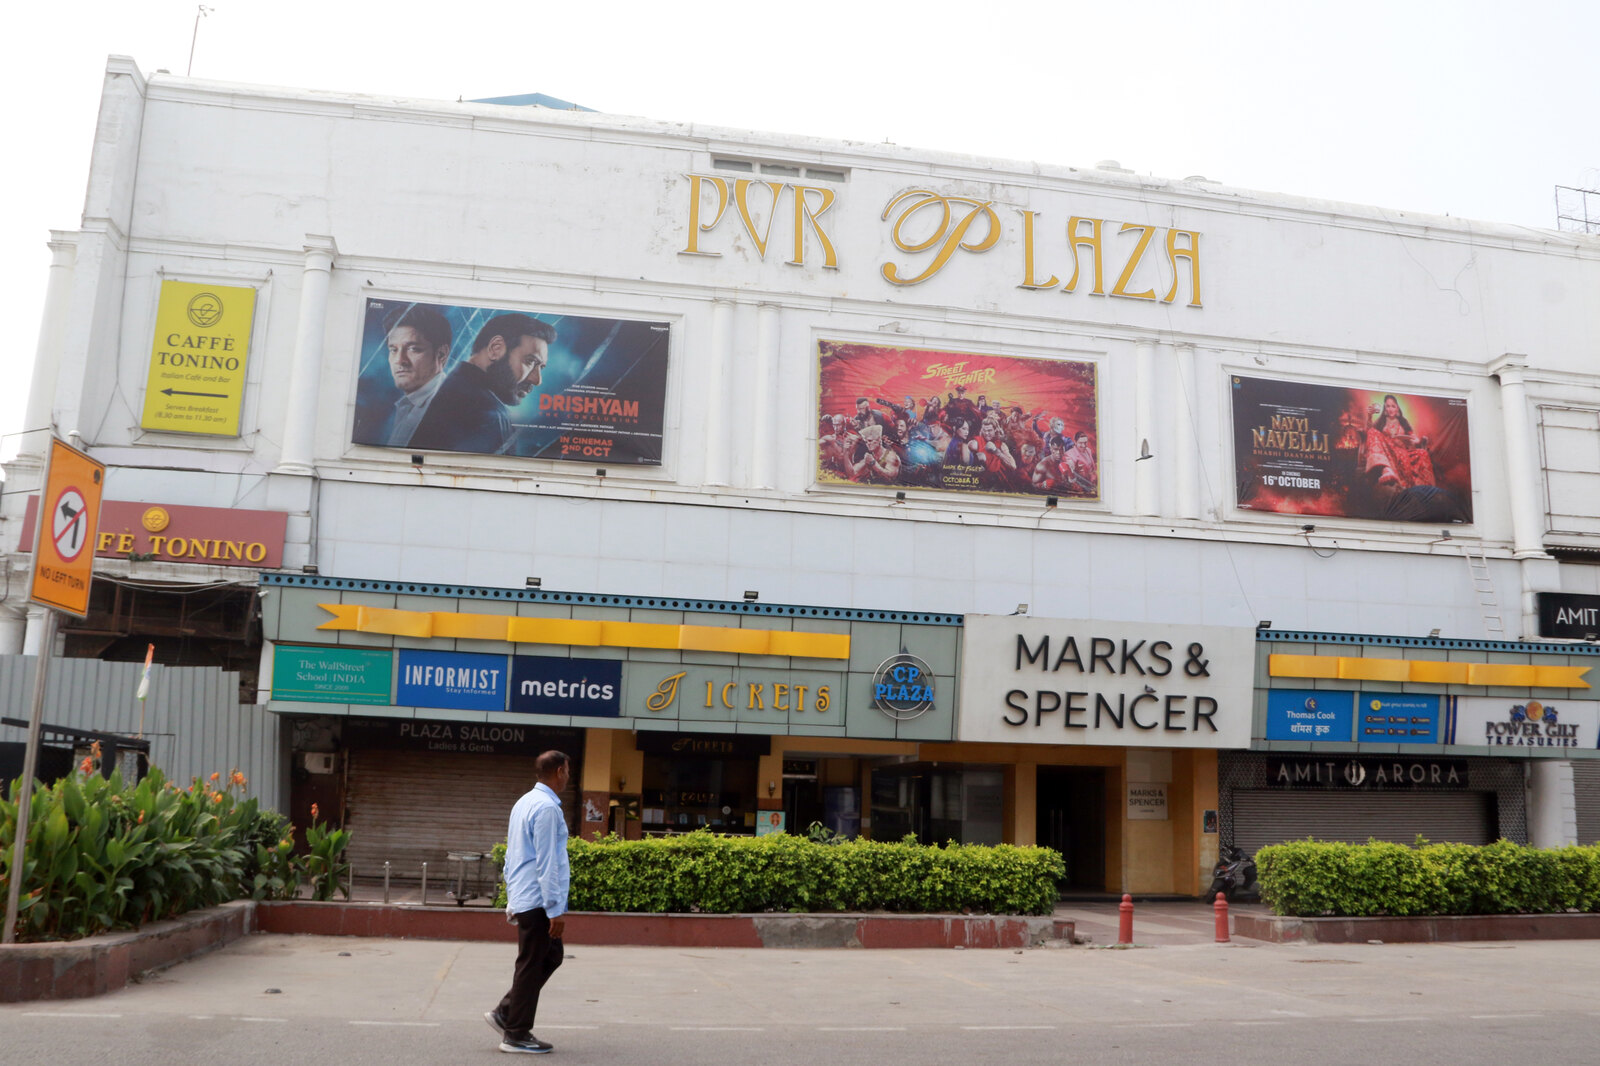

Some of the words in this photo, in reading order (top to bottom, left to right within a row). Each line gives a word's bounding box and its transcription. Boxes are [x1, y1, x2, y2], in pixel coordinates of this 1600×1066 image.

[677, 173, 839, 271] PVR
[880, 188, 1203, 308] PLAZA
[158, 352, 239, 371] TONINO
[920, 361, 969, 379] STREET
[944, 367, 997, 388] FIGHTER
[539, 393, 639, 418] DRISHYAM
[1271, 414, 1308, 433] NAYYI
[572, 436, 613, 446] CINEMAS
[1251, 426, 1329, 454] NAVELLI
[561, 444, 581, 455] 2ND
[583, 445, 611, 457] OCT
[1278, 476, 1320, 489] OCTOBER
[148, 535, 267, 562] TONINO
[52, 570, 67, 584] LEFT
[1556, 607, 1598, 626] AMIT
[1015, 633, 1173, 677] MARKS
[1183, 642, 1210, 677] &
[299, 659, 316, 670] The
[319, 660, 365, 672] WallStreet
[894, 666, 919, 683] CP
[296, 671, 327, 682] School
[333, 673, 365, 684] INDIA
[405, 664, 499, 690] INFORMIST
[446, 687, 461, 695] Stay
[463, 688, 496, 696] Informed
[521, 676, 614, 700] metrics
[646, 671, 830, 713] TICKETS
[875, 684, 934, 702] PLAZA
[1003, 689, 1218, 732] SPENCER
[1286, 710, 1315, 719] Thomas
[1317, 711, 1335, 720] Cook
[400, 723, 453, 740] PLAZA
[459, 725, 525, 743] SALOON
[1486, 721, 1542, 737] POWER
[428, 740, 457, 751] Ladies
[459, 742, 466, 751] &
[468, 742, 494, 753] Gents
[1486, 736, 1578, 747] TREASURIES
[1277, 762, 1336, 782] AMIT
[1375, 763, 1460, 784] ARORA
[1130, 789, 1157, 797] MARKS
[1157, 789, 1163, 797] &
[1129, 798, 1165, 807] SPENCER
